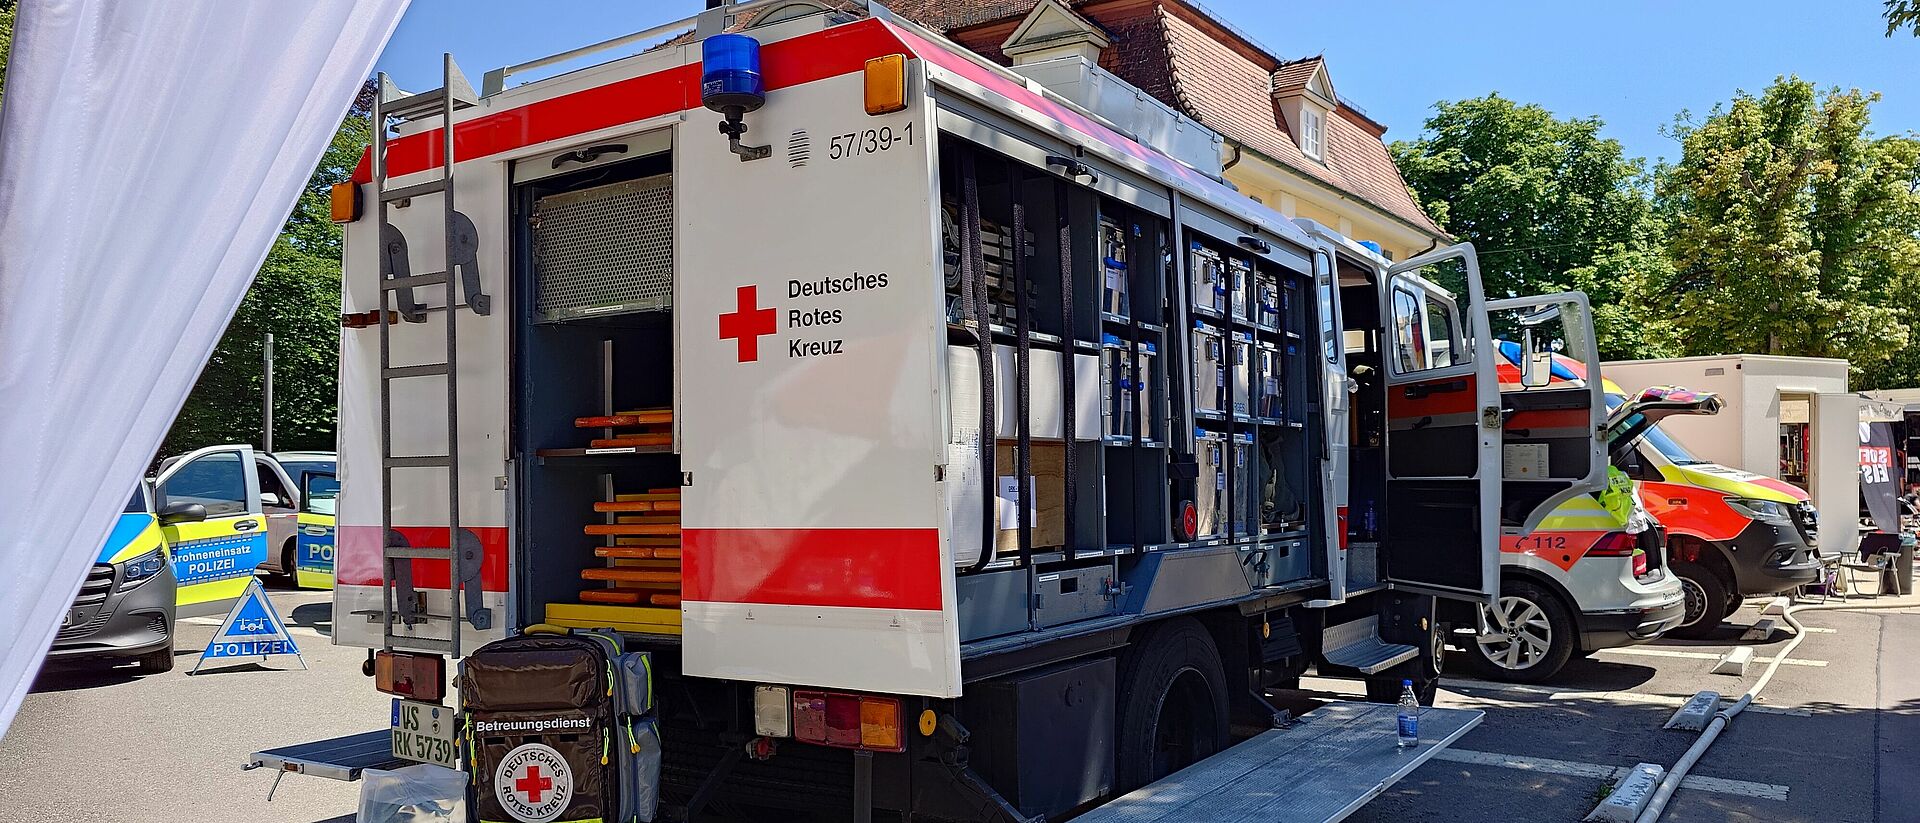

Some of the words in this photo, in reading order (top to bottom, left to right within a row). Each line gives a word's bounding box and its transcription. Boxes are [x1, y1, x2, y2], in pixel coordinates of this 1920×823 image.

[829, 121, 914, 160] 57/39-1
[788, 271, 889, 299] Deutsches
[788, 308, 843, 329] Rotes
[788, 338, 844, 358] Kreuz
[1534, 536, 1566, 549] 112
[170, 545, 252, 564] Drohneneinsatz
[188, 558, 235, 575] POLIZEI
[213, 641, 288, 657] POLIZEI
[402, 705, 419, 731] VS
[476, 717, 591, 732] Betreuungsdienst
[394, 730, 413, 757] RK
[416, 734, 451, 763] 5739
[503, 751, 564, 779] DEUTSCHES
[502, 785, 534, 816] ROTES
[536, 784, 566, 817] KREUZ
